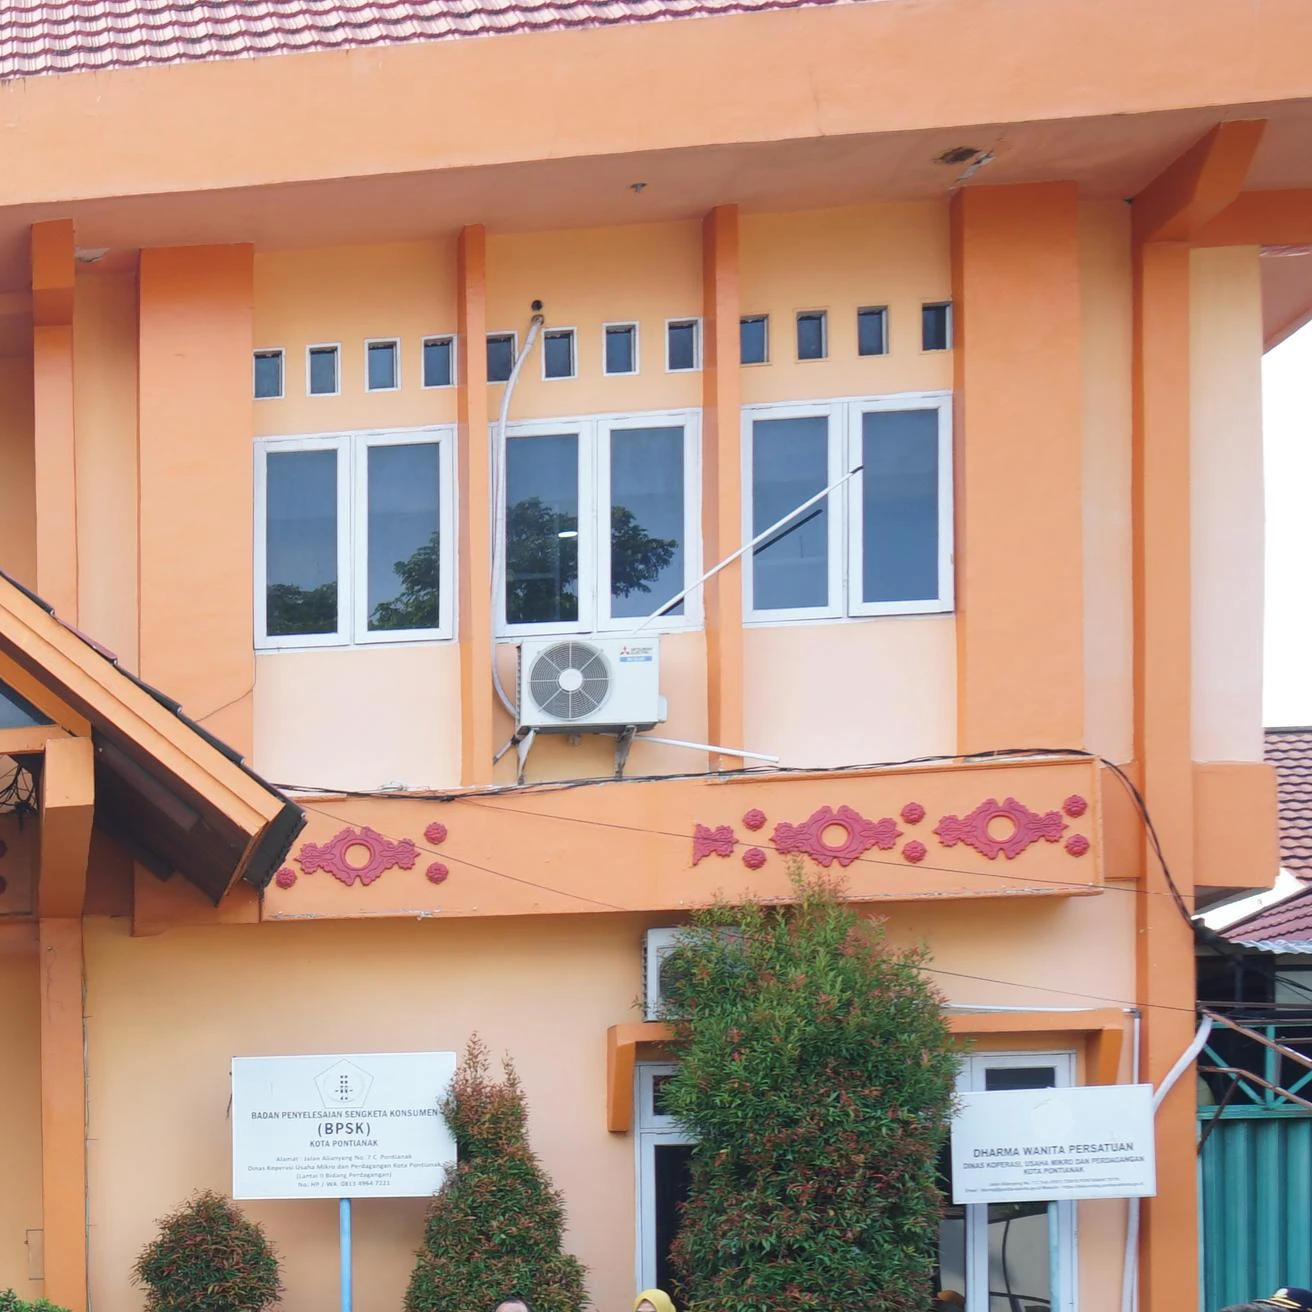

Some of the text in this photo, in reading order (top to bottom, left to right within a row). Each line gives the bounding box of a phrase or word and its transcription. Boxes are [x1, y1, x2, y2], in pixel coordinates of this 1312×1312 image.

[282, 1111, 343, 1119] PENYELESAIAN
[345, 1110, 387, 1118] SENGKETA
[390, 1109, 438, 1117] KONSUMEN
[318, 1122, 371, 1137] (BPSK)
[332, 1139, 378, 1147] PONTIANAK
[973, 1142, 1134, 1158] DHARMA WANITA PERSATUAN
